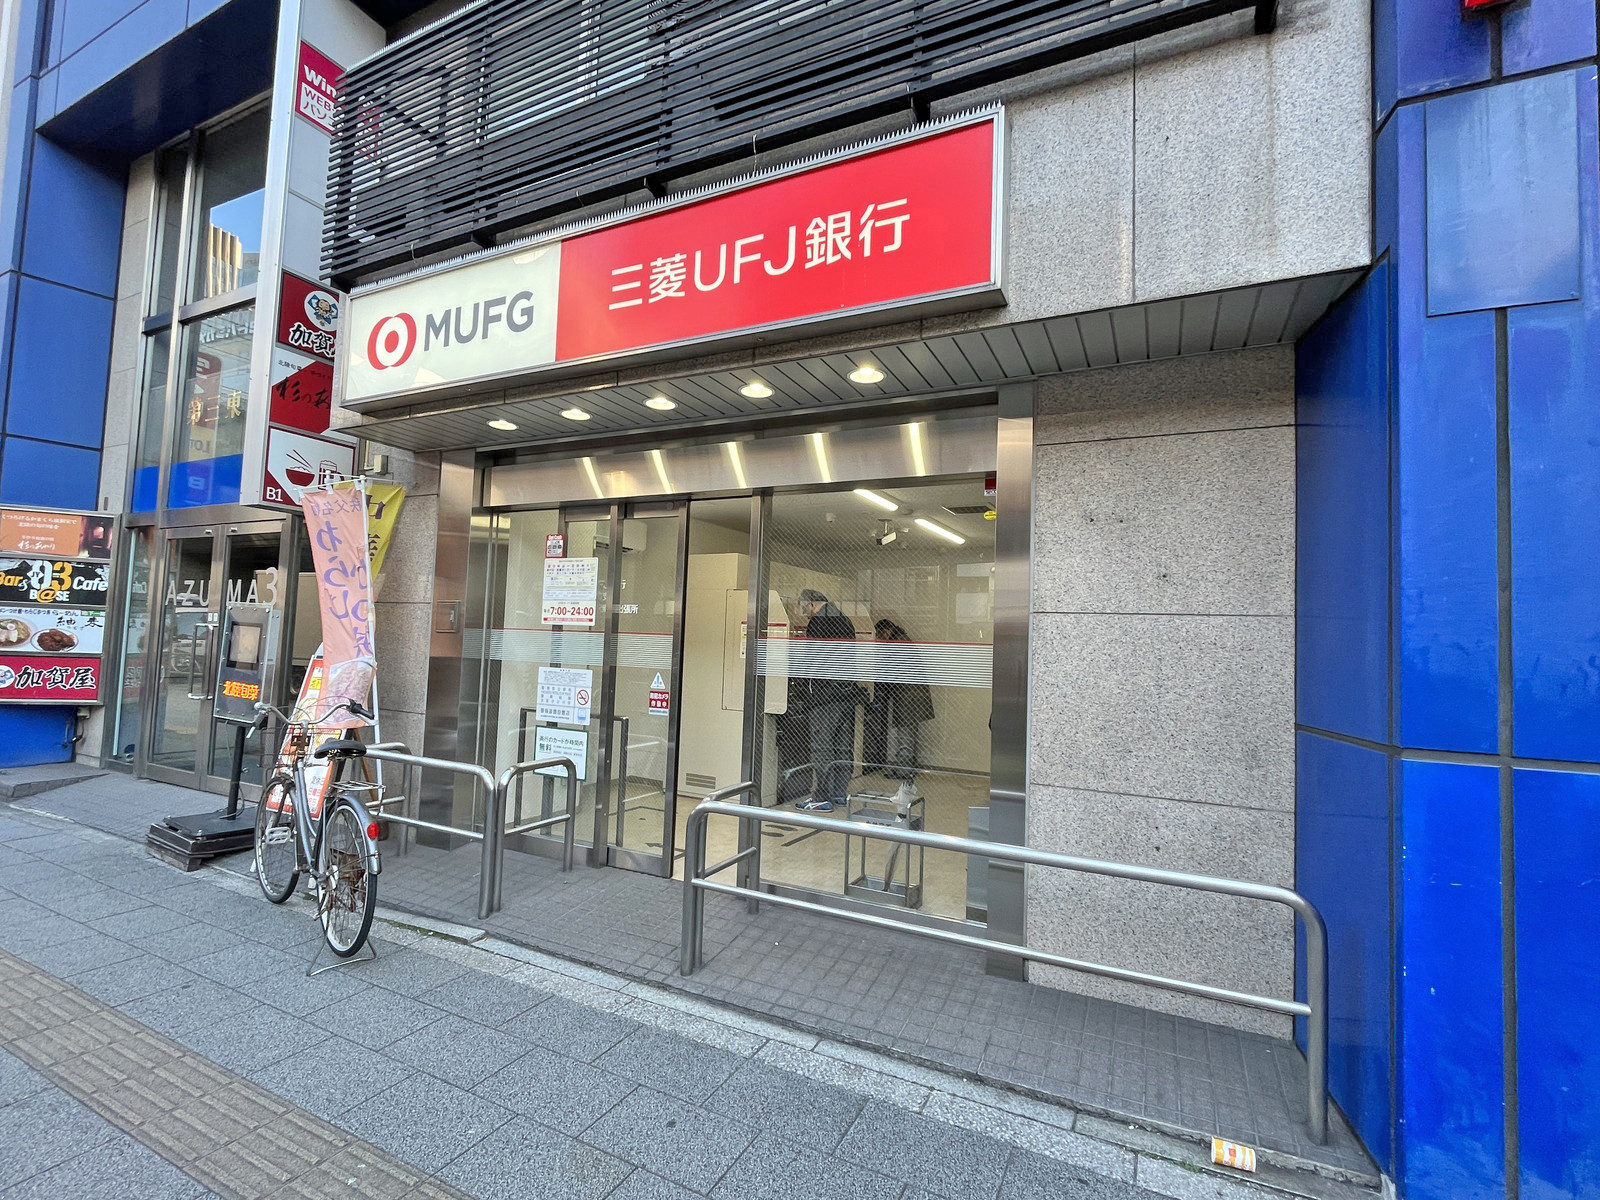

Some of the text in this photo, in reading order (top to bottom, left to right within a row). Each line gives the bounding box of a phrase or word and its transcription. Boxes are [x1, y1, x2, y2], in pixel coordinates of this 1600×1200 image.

[608, 197, 910, 311] 三菱UFJ銀行
[423, 290, 534, 351] MUFG
[288, 321, 337, 357] 加賀
[266, 486, 283, 502] B1
[15, 665, 96, 690] 加賀屋
